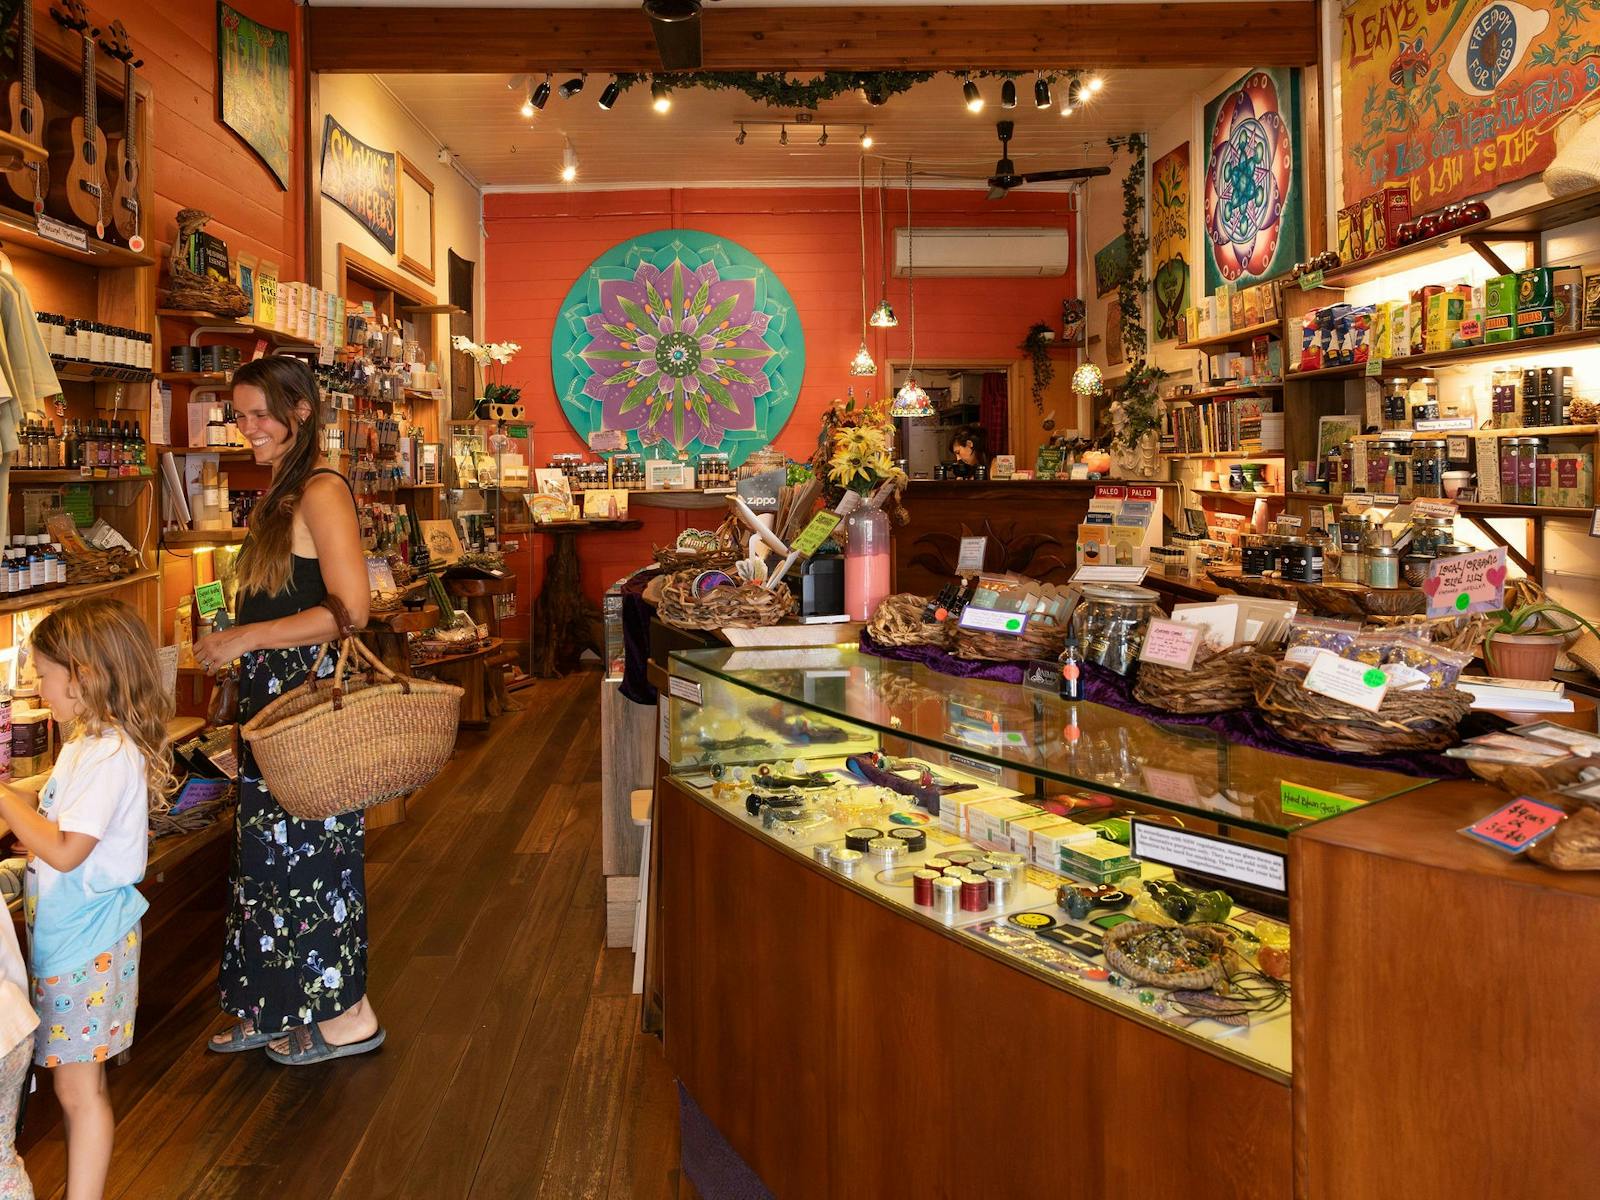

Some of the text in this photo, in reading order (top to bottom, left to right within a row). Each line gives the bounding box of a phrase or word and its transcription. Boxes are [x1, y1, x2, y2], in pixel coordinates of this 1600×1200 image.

[1347, 0, 1418, 71] LEAVE
[1469, 58, 1489, 87] FOR
[1462, 97, 1524, 150] HERAL
[1523, 70, 1574, 120] TEAS
[330, 127, 391, 192] SMOKING
[1428, 154, 1464, 198] LAW
[1473, 143, 1497, 176] IS
[1497, 124, 1540, 168] THE
[746, 496, 776, 506] zippo
[1131, 489, 1152, 497] PALEO
[1283, 791, 1300, 804] Hand
